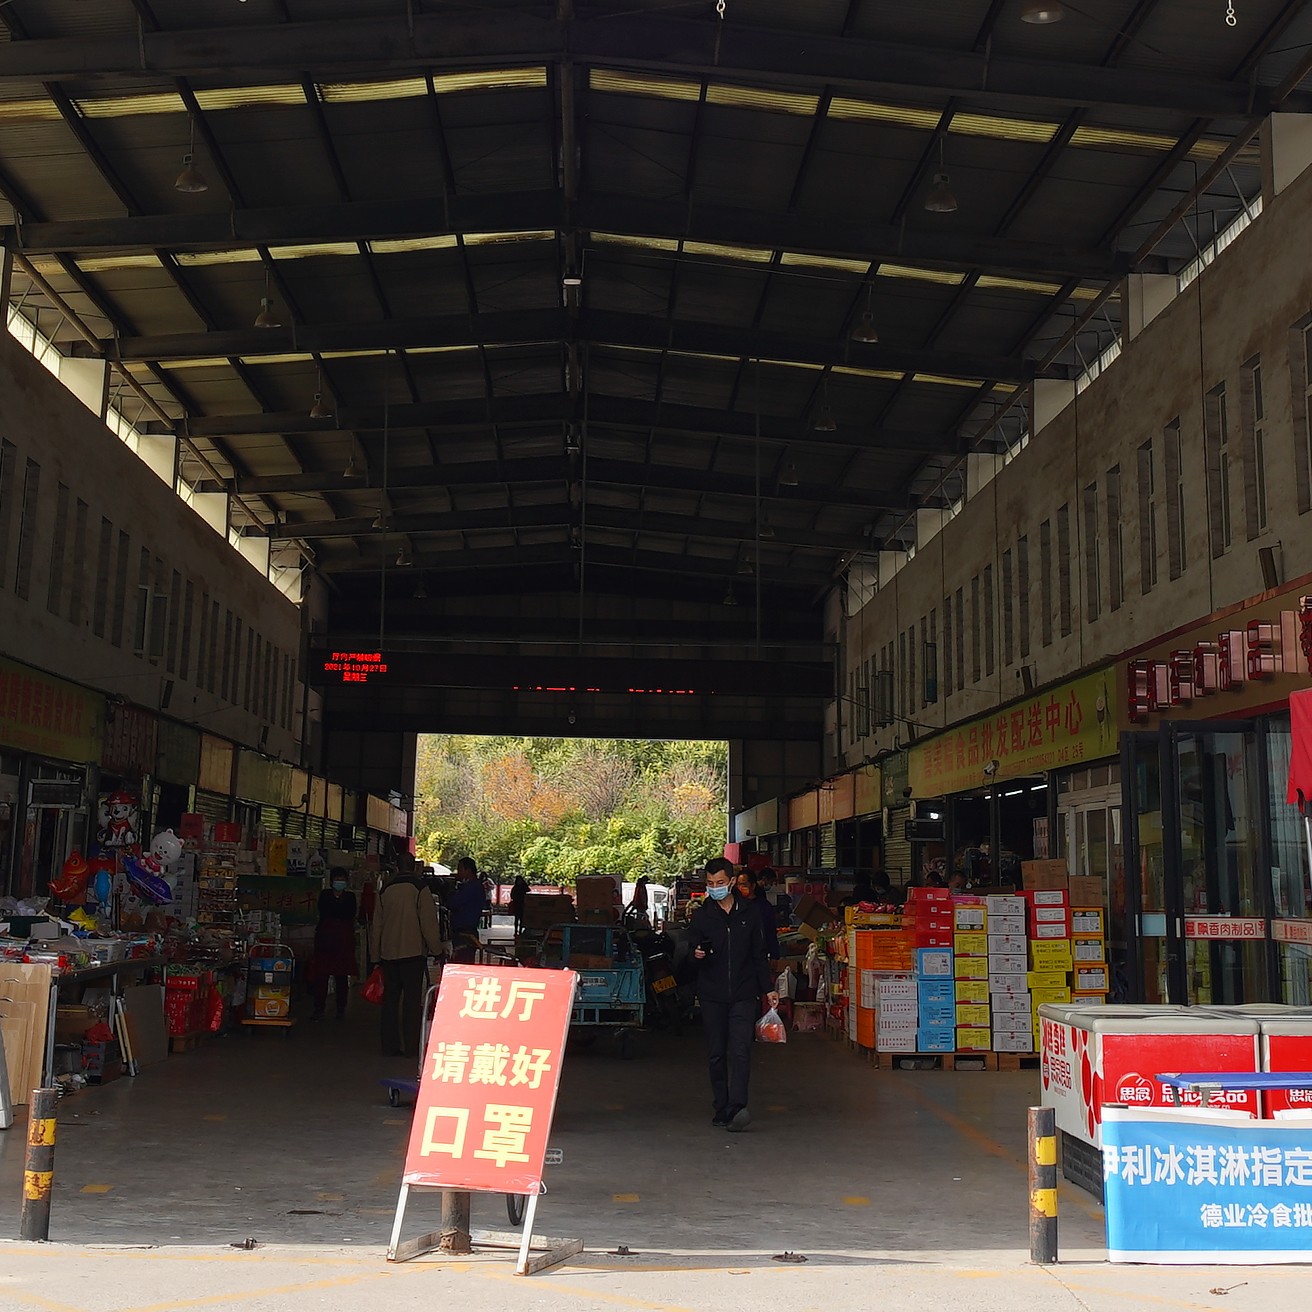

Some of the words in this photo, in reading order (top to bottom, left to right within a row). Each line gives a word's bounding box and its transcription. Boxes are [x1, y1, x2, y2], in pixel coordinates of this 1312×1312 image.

[459, 977, 546, 1022] 进厅
[431, 1041, 552, 1089] 请戴好
[420, 1103, 534, 1168] 口罩
